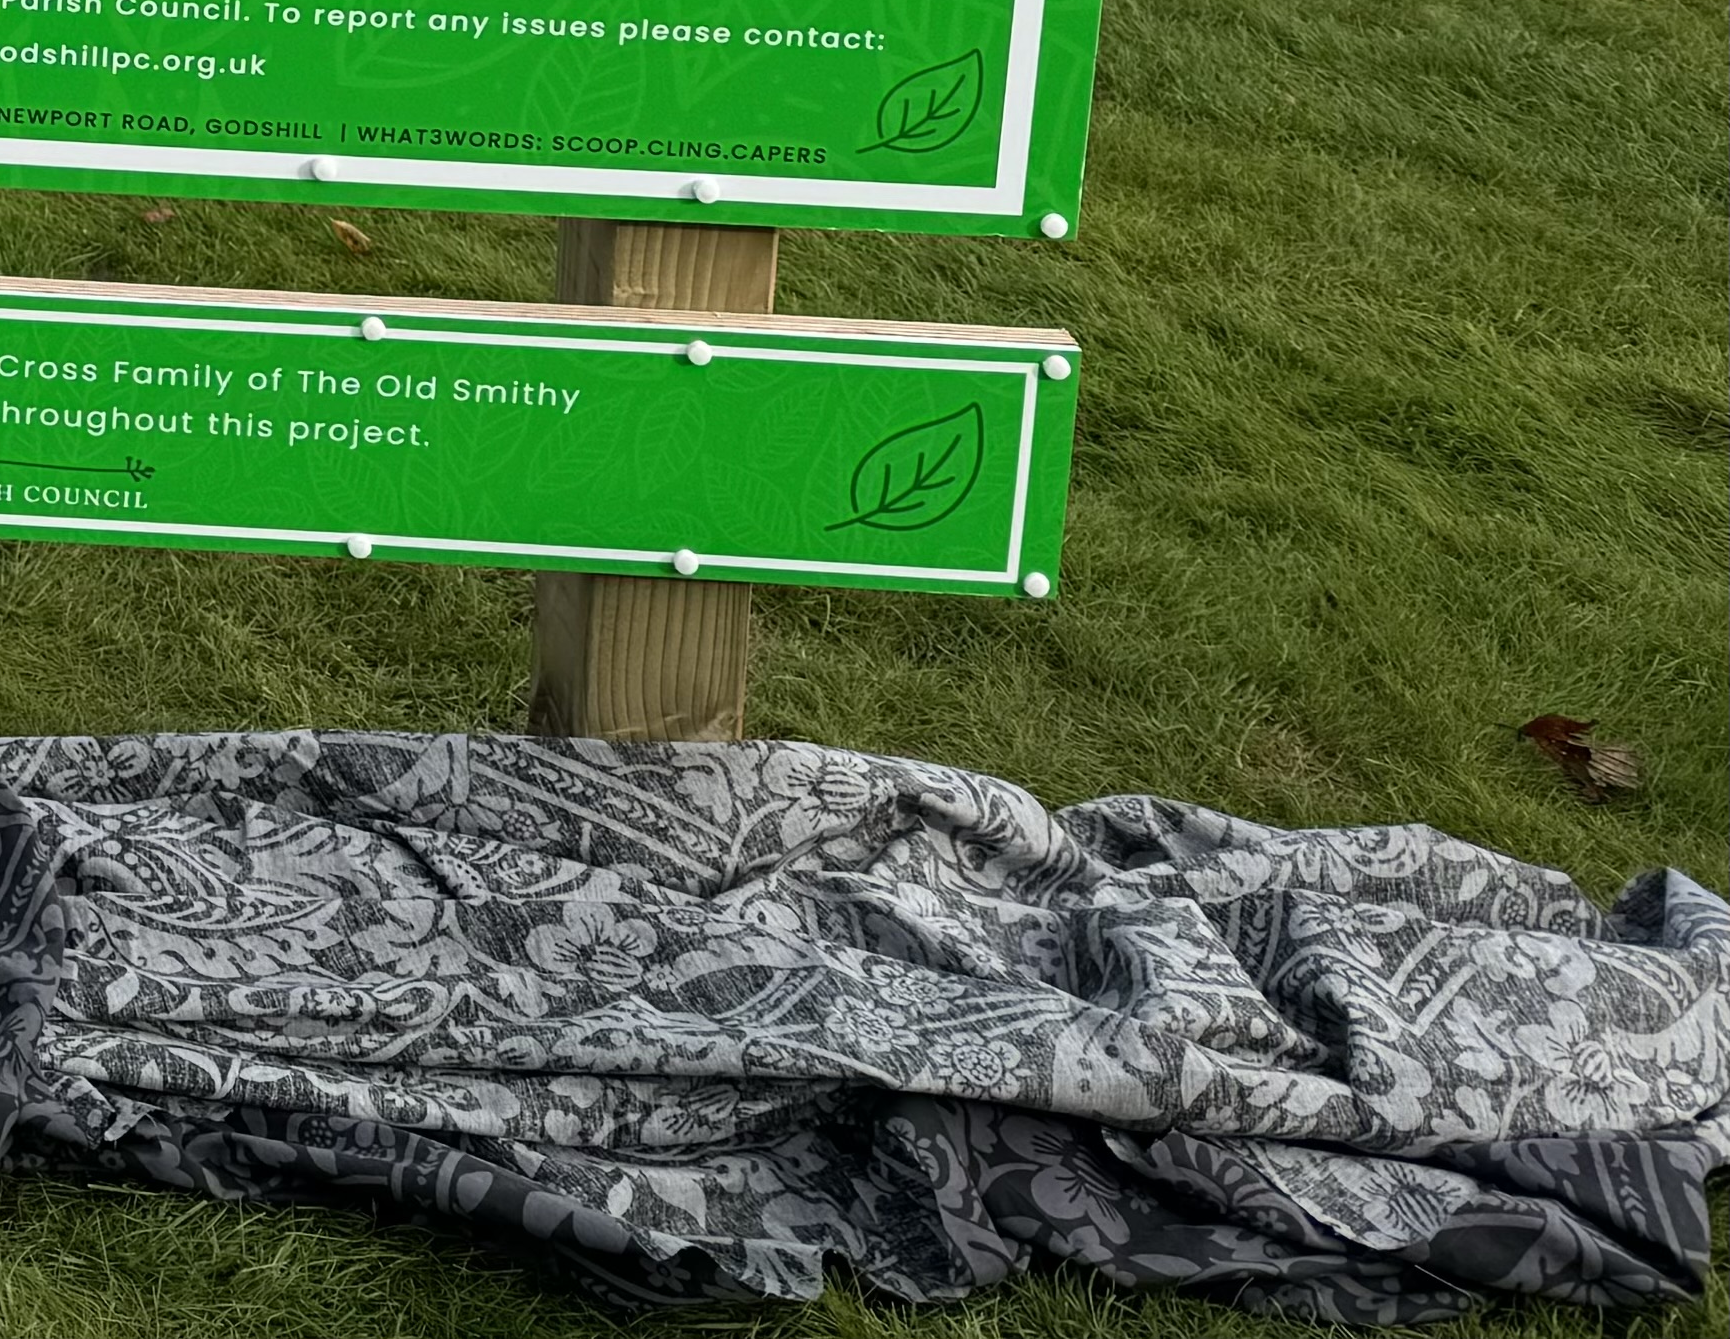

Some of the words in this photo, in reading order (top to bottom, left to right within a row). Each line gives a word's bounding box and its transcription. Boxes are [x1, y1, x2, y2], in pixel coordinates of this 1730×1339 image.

[263, 1, 302, 25] To
[313, 7, 417, 35] report
[427, 12, 490, 40] any
[501, 10, 606, 39] issues
[617, 17, 732, 47] please
[742, 26, 886, 52] contact:
[120, 112, 197, 137] ROAD,
[204, 117, 323, 141] GODSHILL
[356, 125, 543, 152] WHAT3WORDS:
[551, 134, 827, 166] SCOOP.CLING.CAPERS
[113, 359, 234, 397] Family
[246, 366, 284, 393] of
[296, 369, 362, 396] The
[375, 373, 438, 401] Old
[452, 377, 581, 416] Smithy
[207, 411, 274, 439] this
[287, 417, 430, 451] project.
[22, 484, 149, 510] COUNCIL
